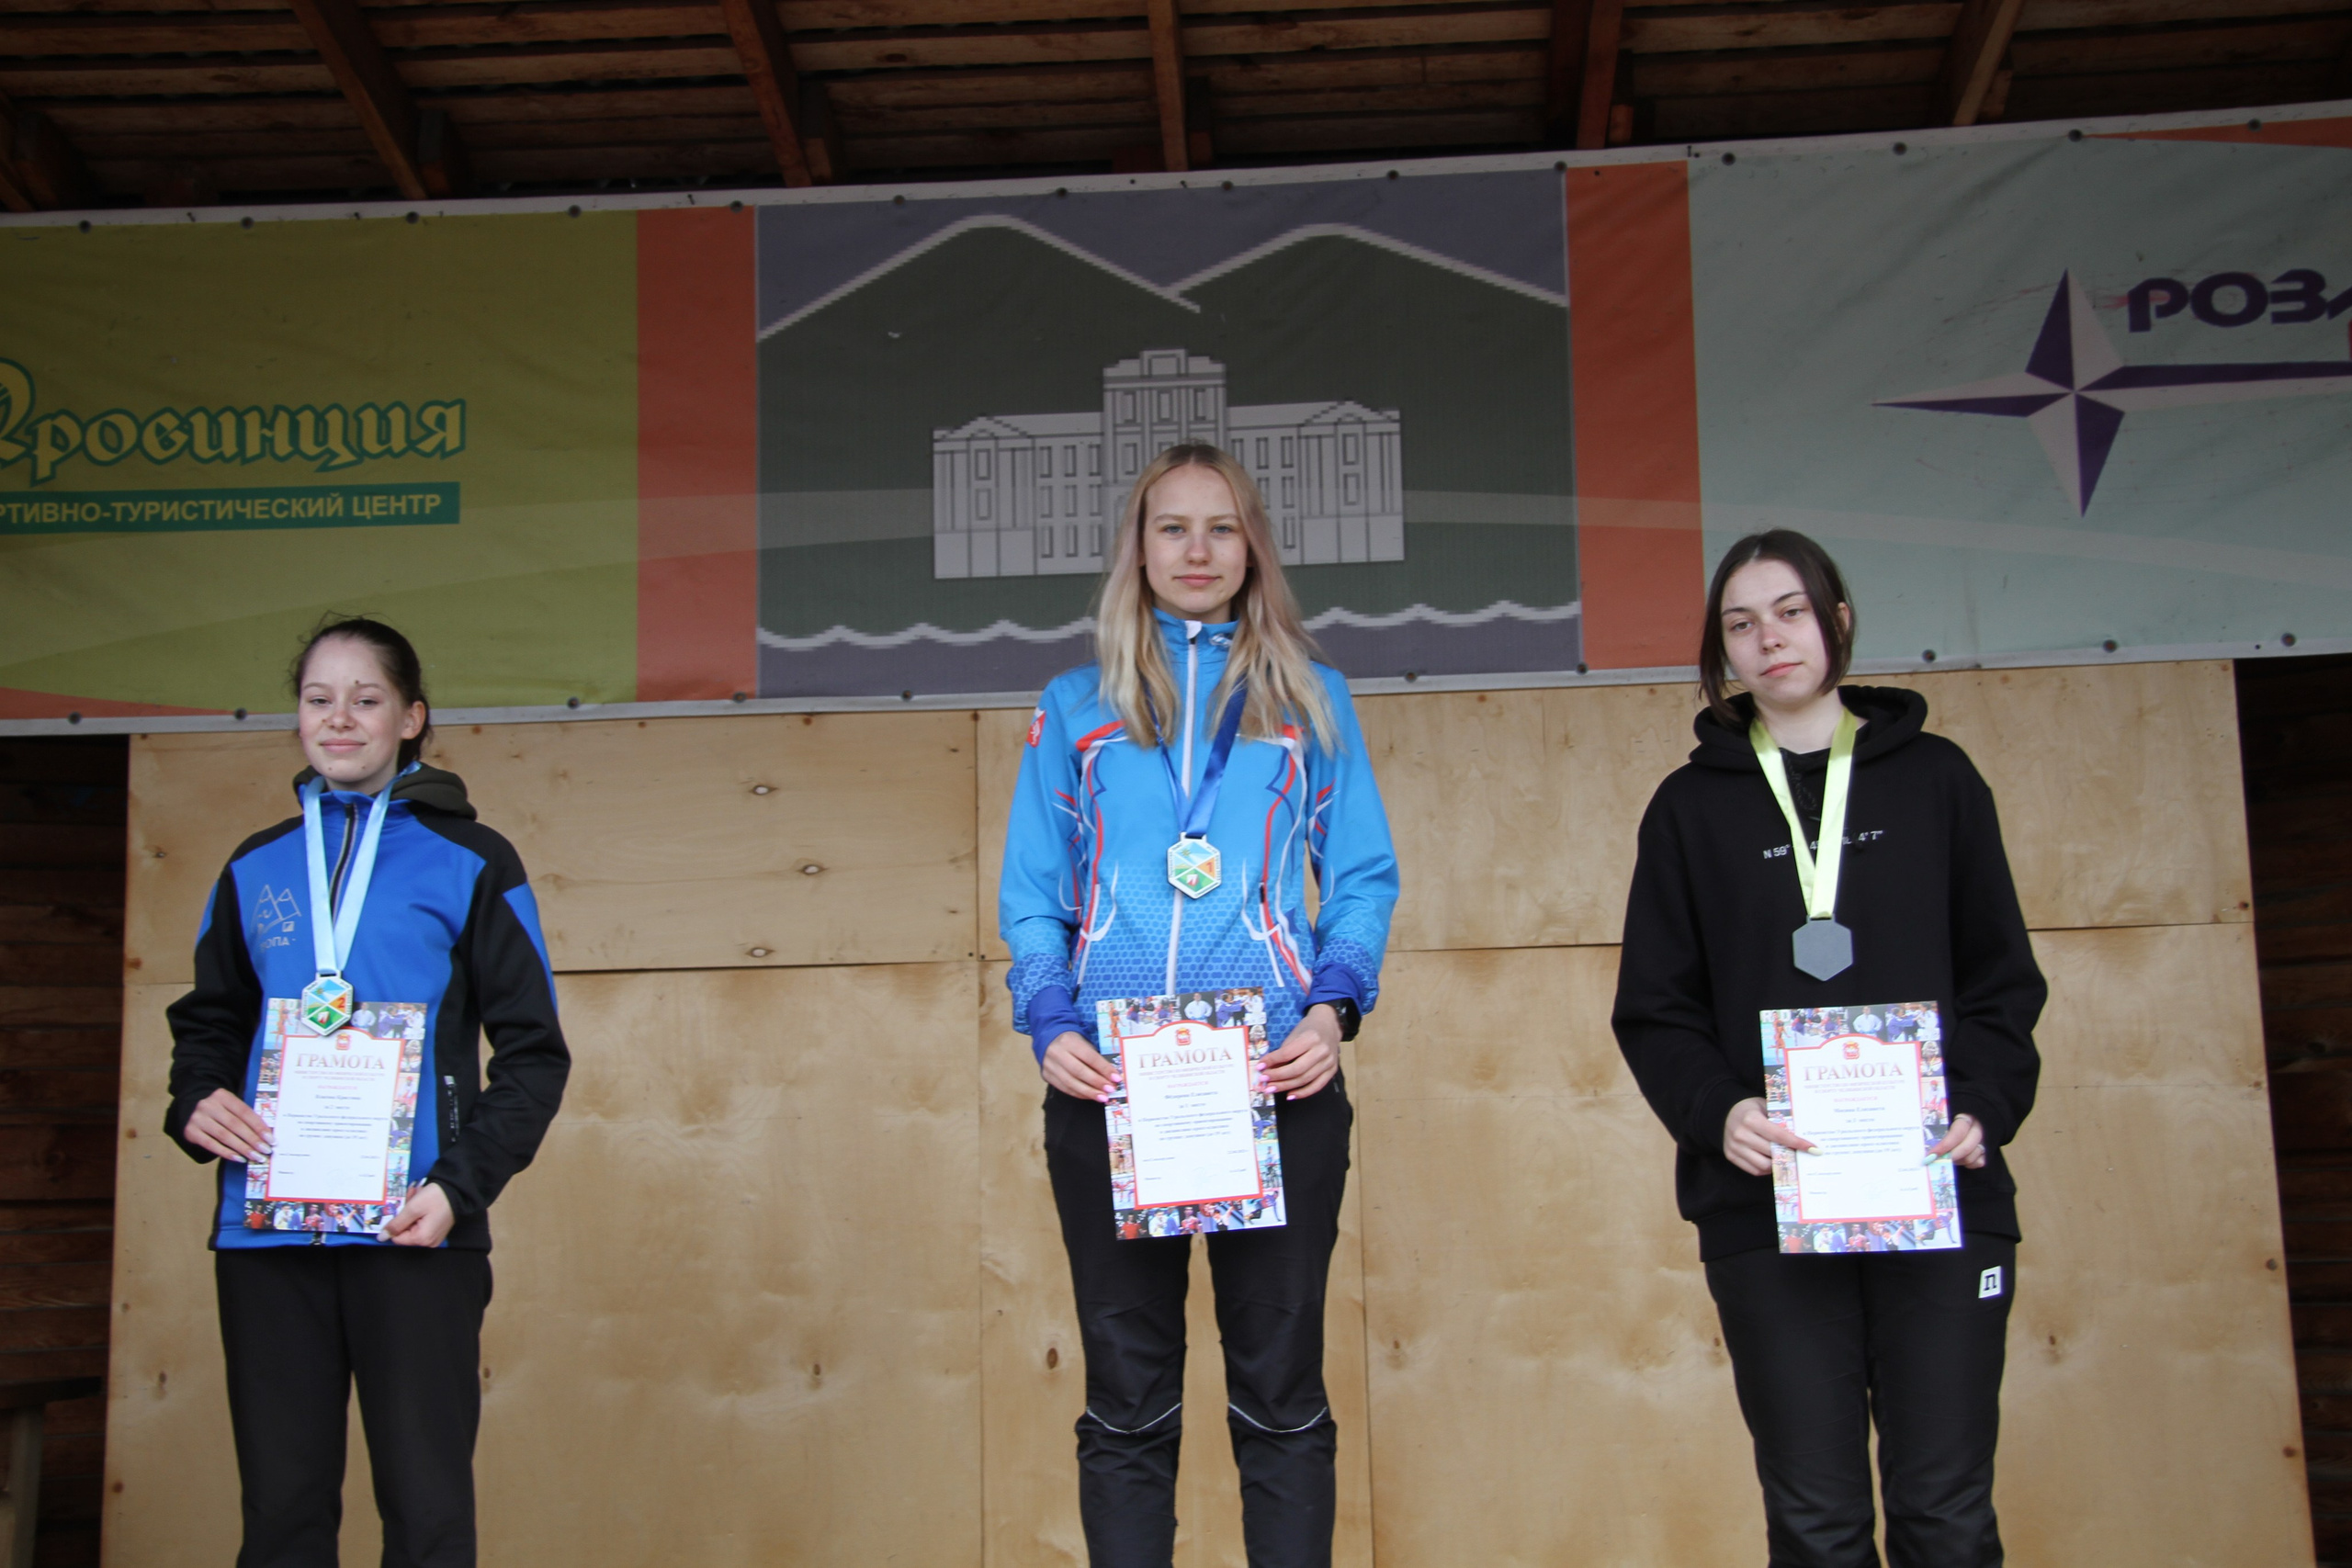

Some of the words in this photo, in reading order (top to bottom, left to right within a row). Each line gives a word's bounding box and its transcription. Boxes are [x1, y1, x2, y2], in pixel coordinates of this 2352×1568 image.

[352, 493, 442, 520] ЦЕНТР
[1206, 862, 1214, 873] 1
[336, 997, 345, 1009] 2
[295, 1052, 386, 1070] ГРАМОТА
[1137, 1046, 1234, 1069] ГРАМОТА
[1802, 1061, 1904, 1082] ГРАМОТА
